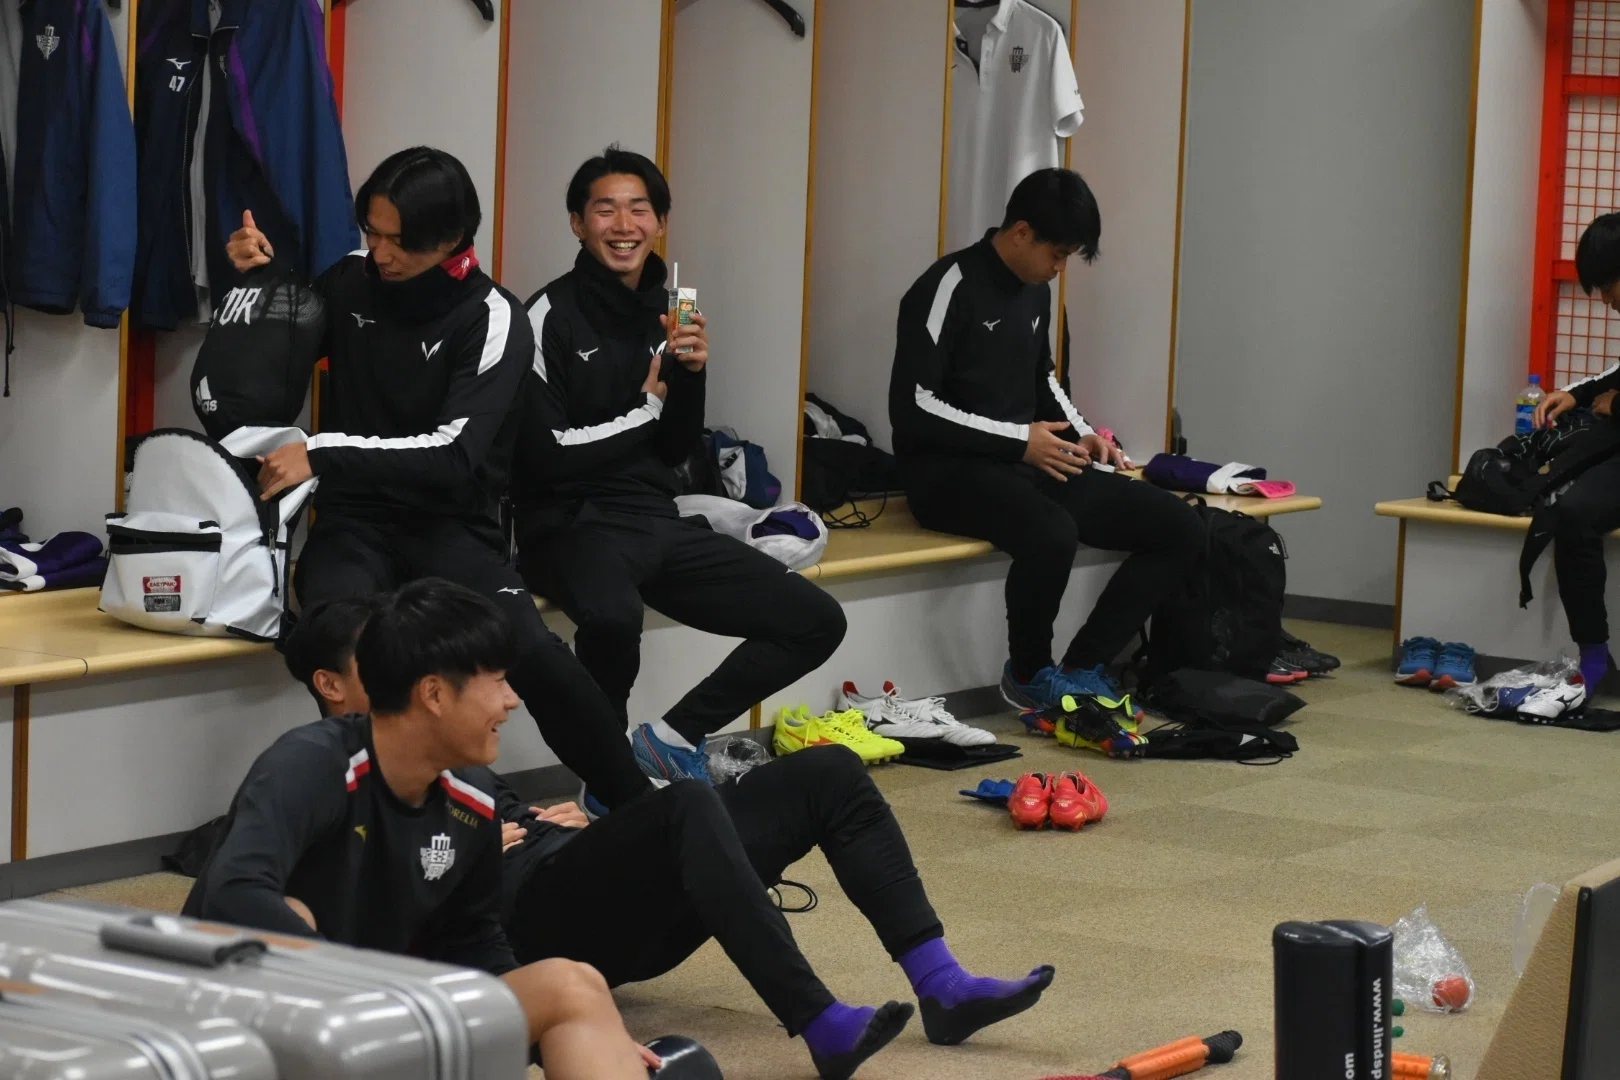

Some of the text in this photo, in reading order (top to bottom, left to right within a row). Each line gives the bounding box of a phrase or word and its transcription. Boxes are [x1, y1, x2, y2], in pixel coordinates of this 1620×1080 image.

[169, 75, 186, 92] 47
[210, 287, 262, 326] OR
[445, 800, 478, 829] ORELIA
